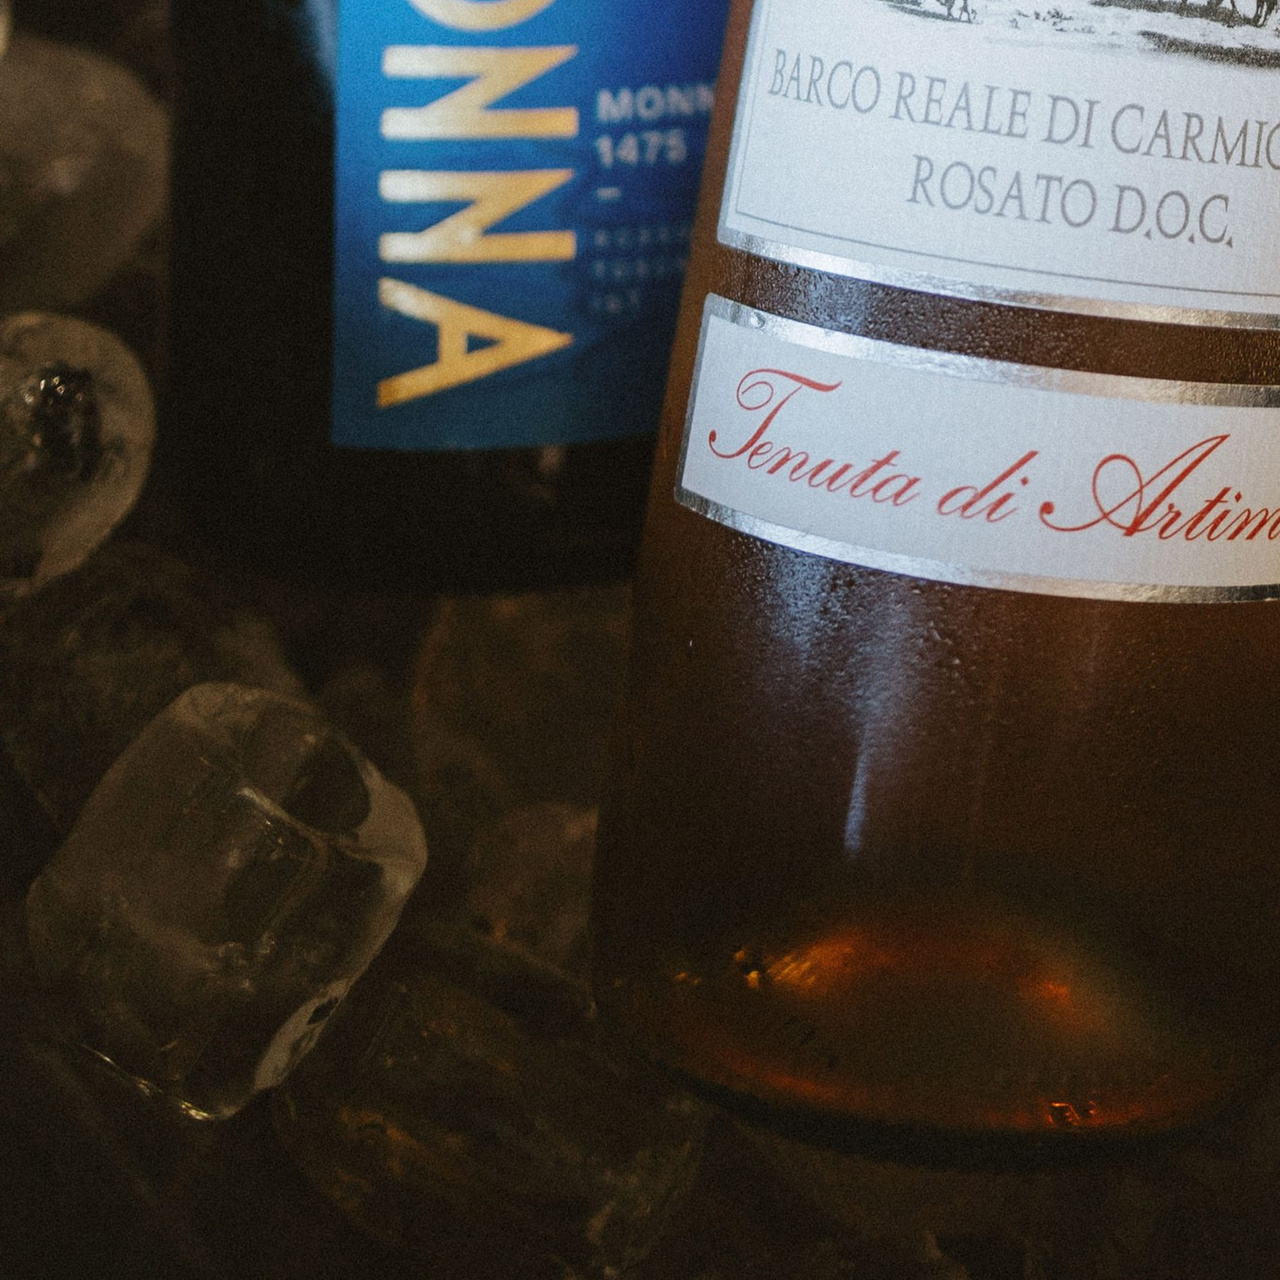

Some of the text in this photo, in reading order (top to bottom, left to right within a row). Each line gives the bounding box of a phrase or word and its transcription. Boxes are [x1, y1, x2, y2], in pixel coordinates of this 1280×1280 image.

[596, 129, 687, 167] 1475
[766, 48, 882, 114] BARCO
[889, 71, 1032, 140] REALE
[1042, 94, 1100, 150] DI
[906, 154, 1235, 249] ROSATO D.O.C.
[708, 368, 921, 508] Tenuta
[936, 450, 1030, 524] di
